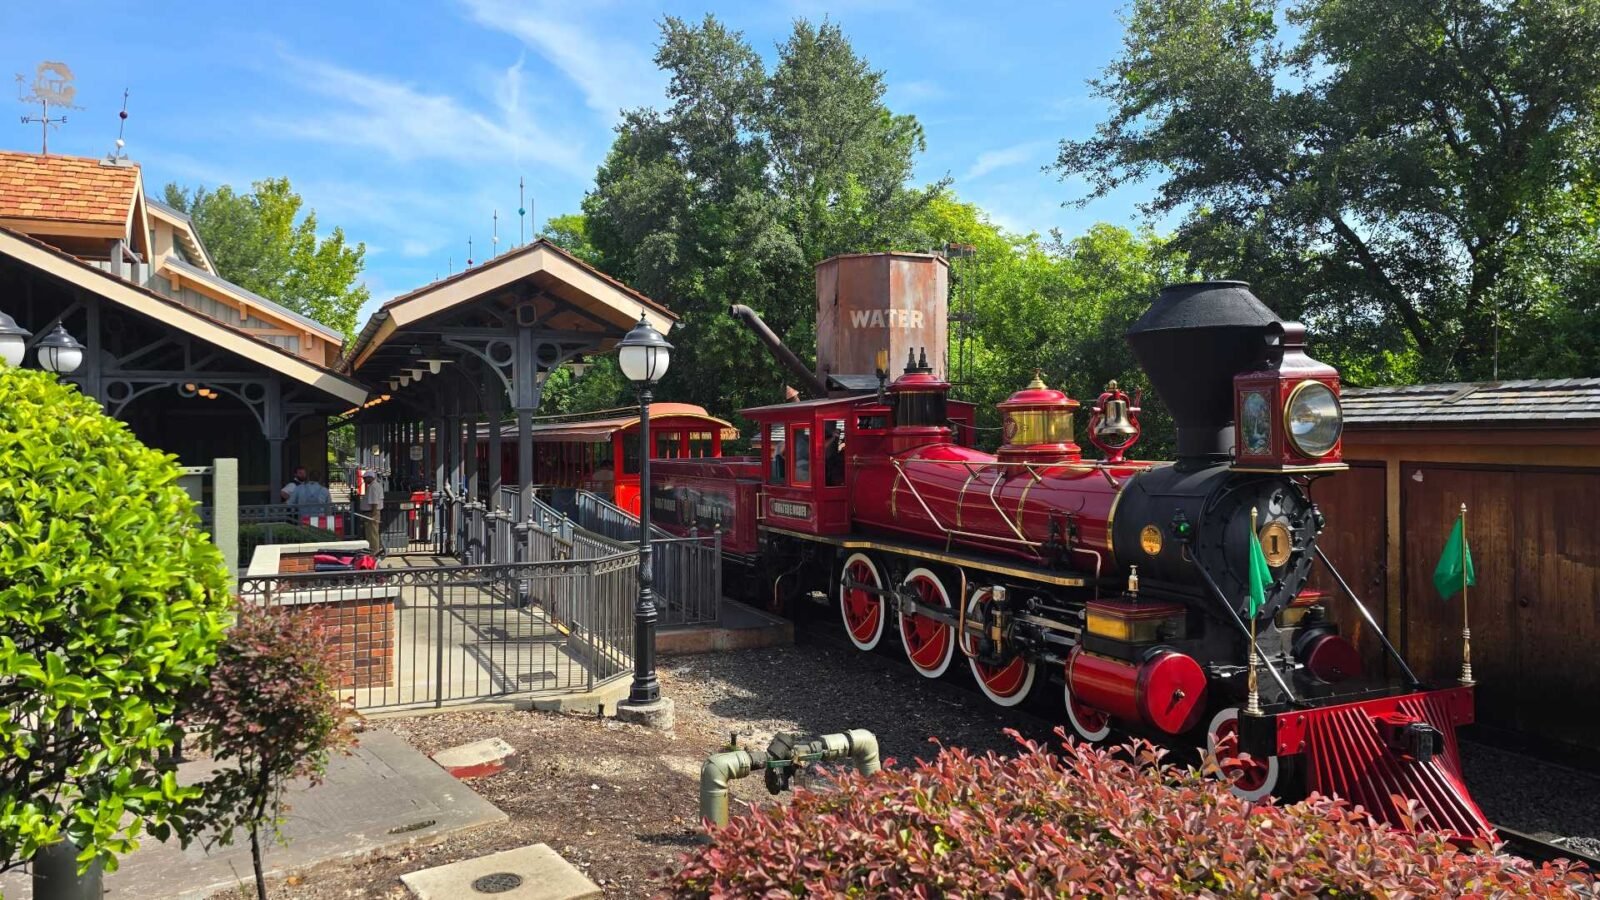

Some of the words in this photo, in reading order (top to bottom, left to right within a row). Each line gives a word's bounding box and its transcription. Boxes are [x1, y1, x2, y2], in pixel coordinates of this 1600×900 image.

[20, 115, 30, 124] W
[62, 115, 68, 124] E
[849, 308, 925, 329] WATER
[1270, 534, 1280, 555] 1
